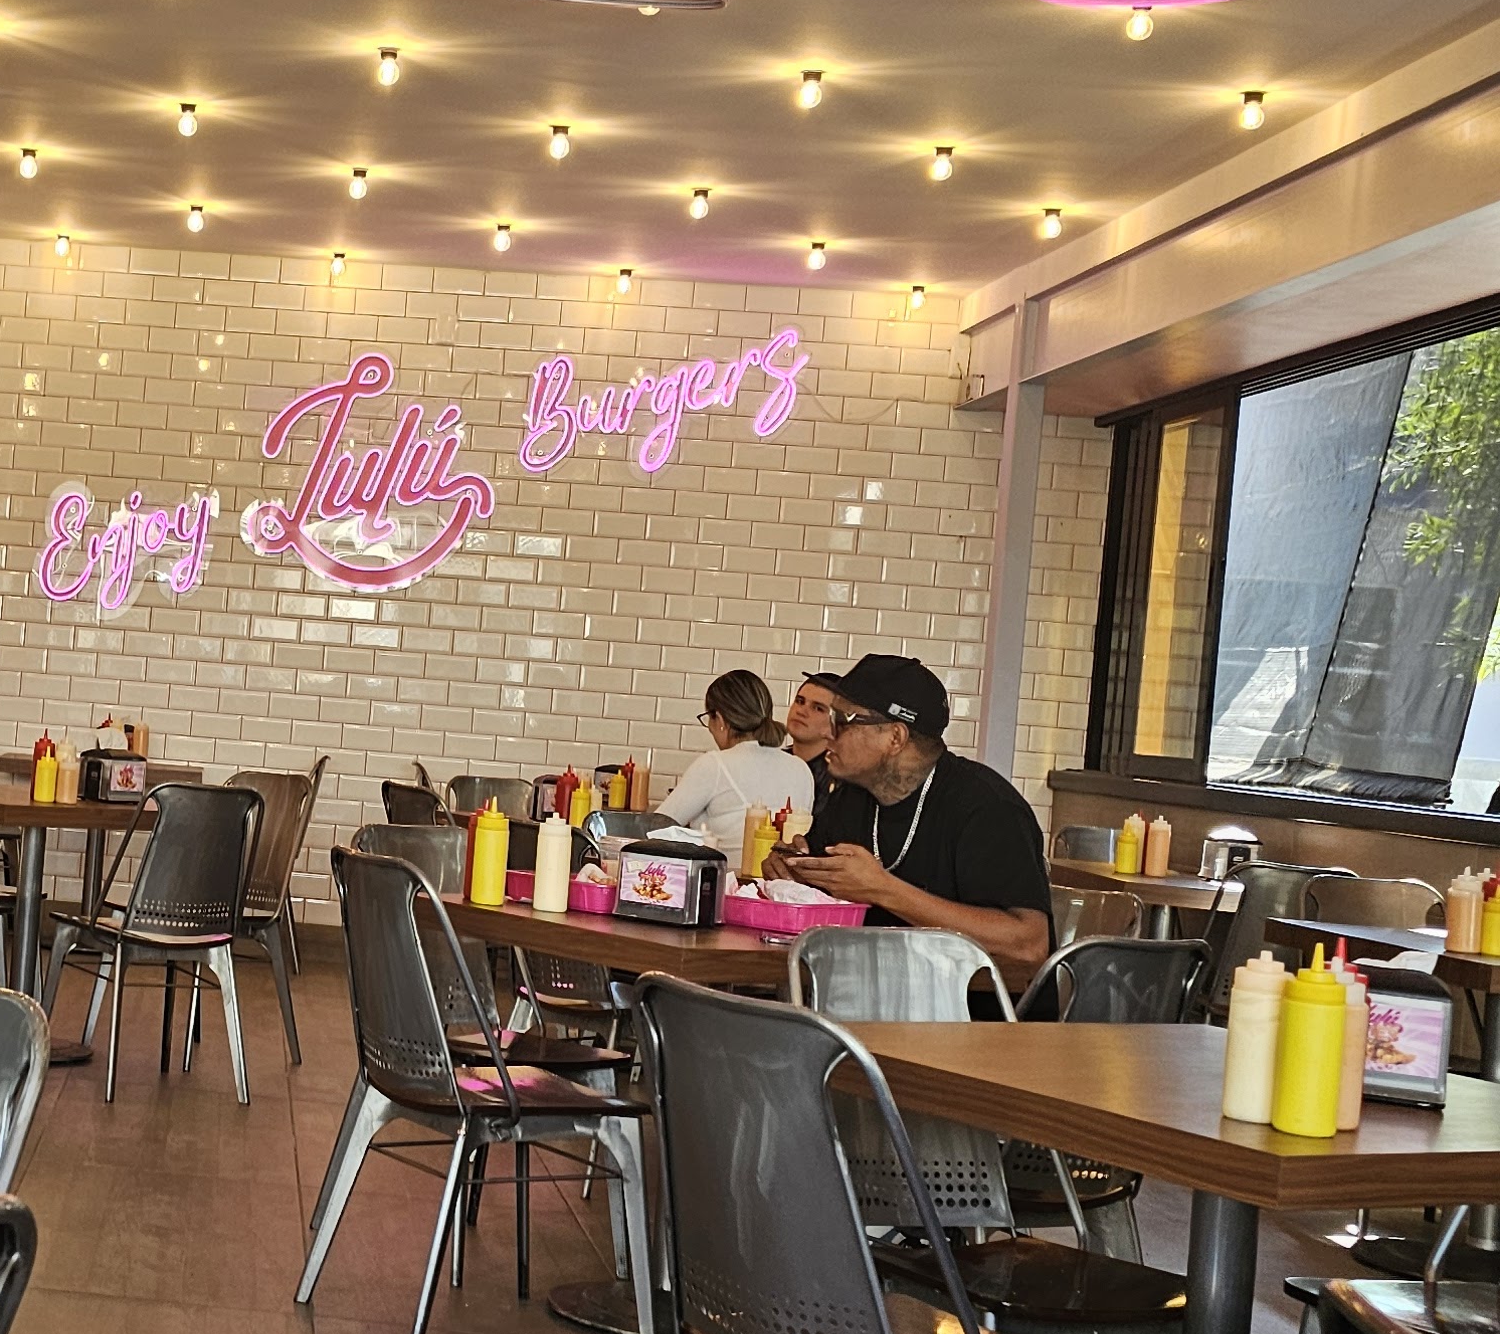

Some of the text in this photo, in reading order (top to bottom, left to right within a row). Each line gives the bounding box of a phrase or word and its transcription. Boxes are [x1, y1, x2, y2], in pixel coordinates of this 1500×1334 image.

[39, 328, 810, 609] Enjoy Lulú Burgers
